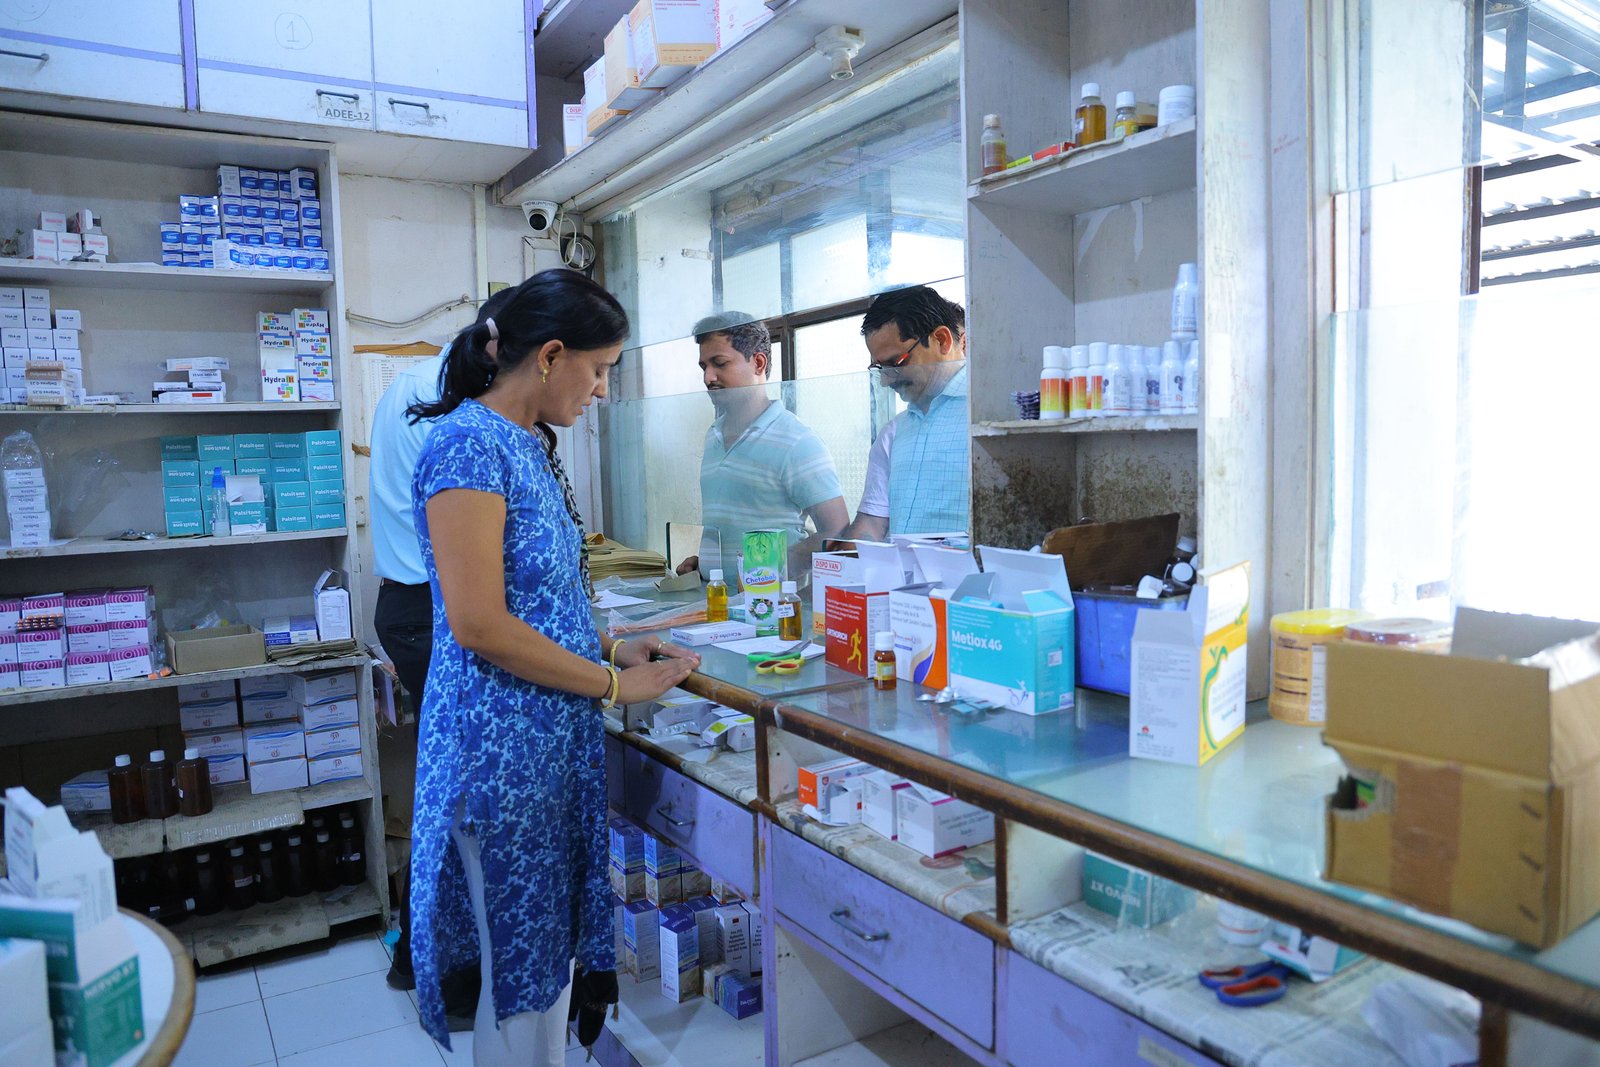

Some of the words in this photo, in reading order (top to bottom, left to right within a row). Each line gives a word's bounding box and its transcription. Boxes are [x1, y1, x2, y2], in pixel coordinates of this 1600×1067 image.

[325, 108, 370, 122] ADEE-12
[815, 621, 825, 630] 3m
[952, 629, 988, 649] Metiox
[988, 639, 1002, 651] 4G
